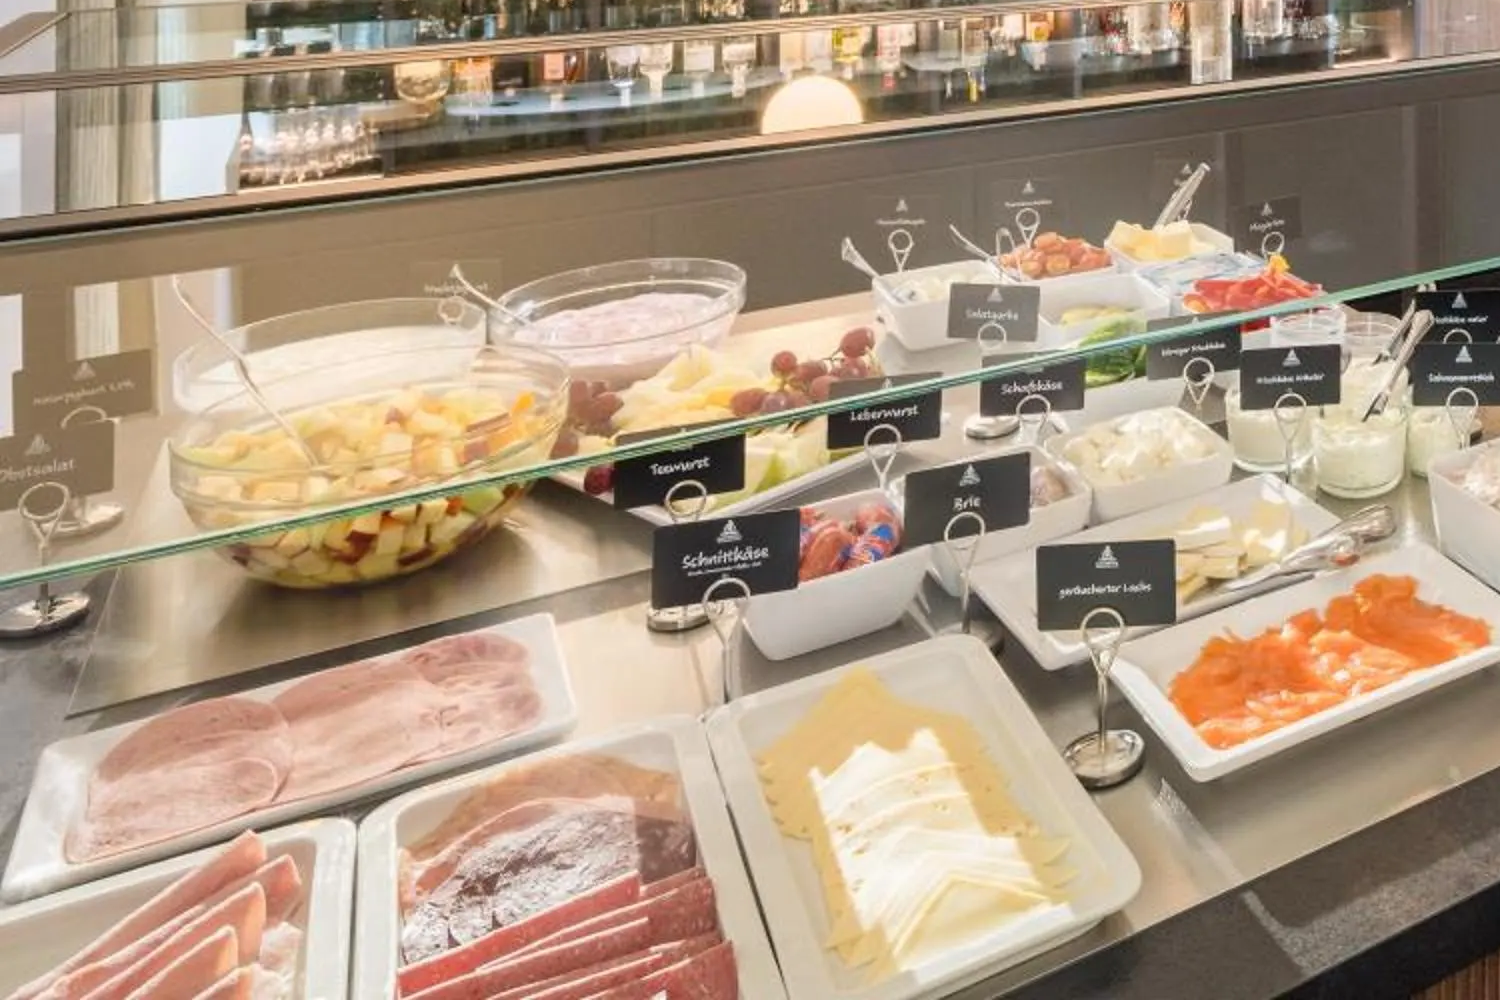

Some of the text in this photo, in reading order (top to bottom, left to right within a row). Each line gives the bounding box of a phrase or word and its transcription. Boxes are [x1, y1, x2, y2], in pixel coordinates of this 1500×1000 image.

[849, 403, 919, 421] Leberwurst
[649, 456, 711, 475] Teewurst
[952, 494, 982, 512] Brie
[682, 545, 769, 569] Schnittkäse
